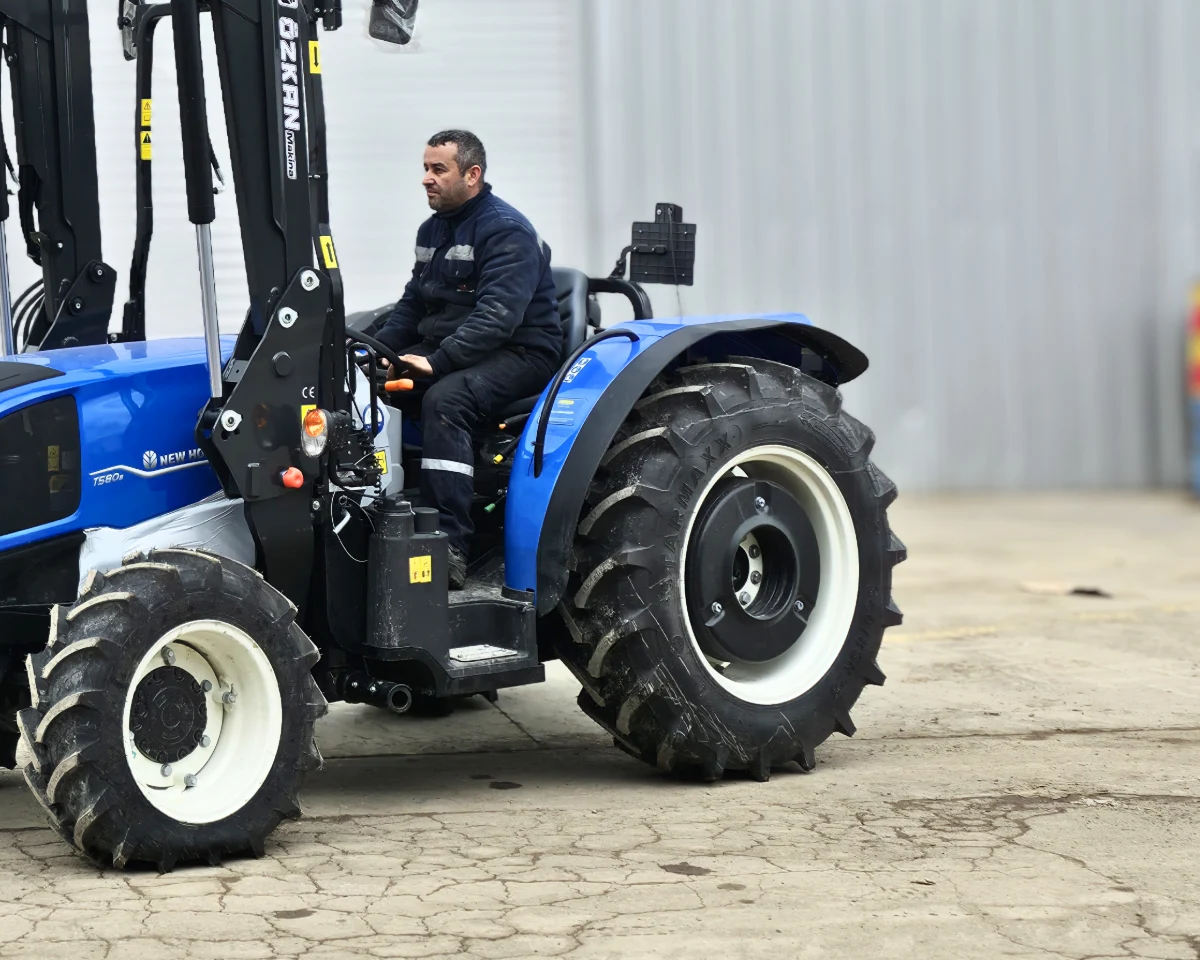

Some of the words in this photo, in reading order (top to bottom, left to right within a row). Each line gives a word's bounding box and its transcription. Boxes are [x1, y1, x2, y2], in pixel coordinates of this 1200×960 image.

[278, 16, 300, 131] ÖZKAN
[285, 131, 297, 179] Makina
[302, 386, 315, 398] CE
[160, 451, 186, 466] NEW
